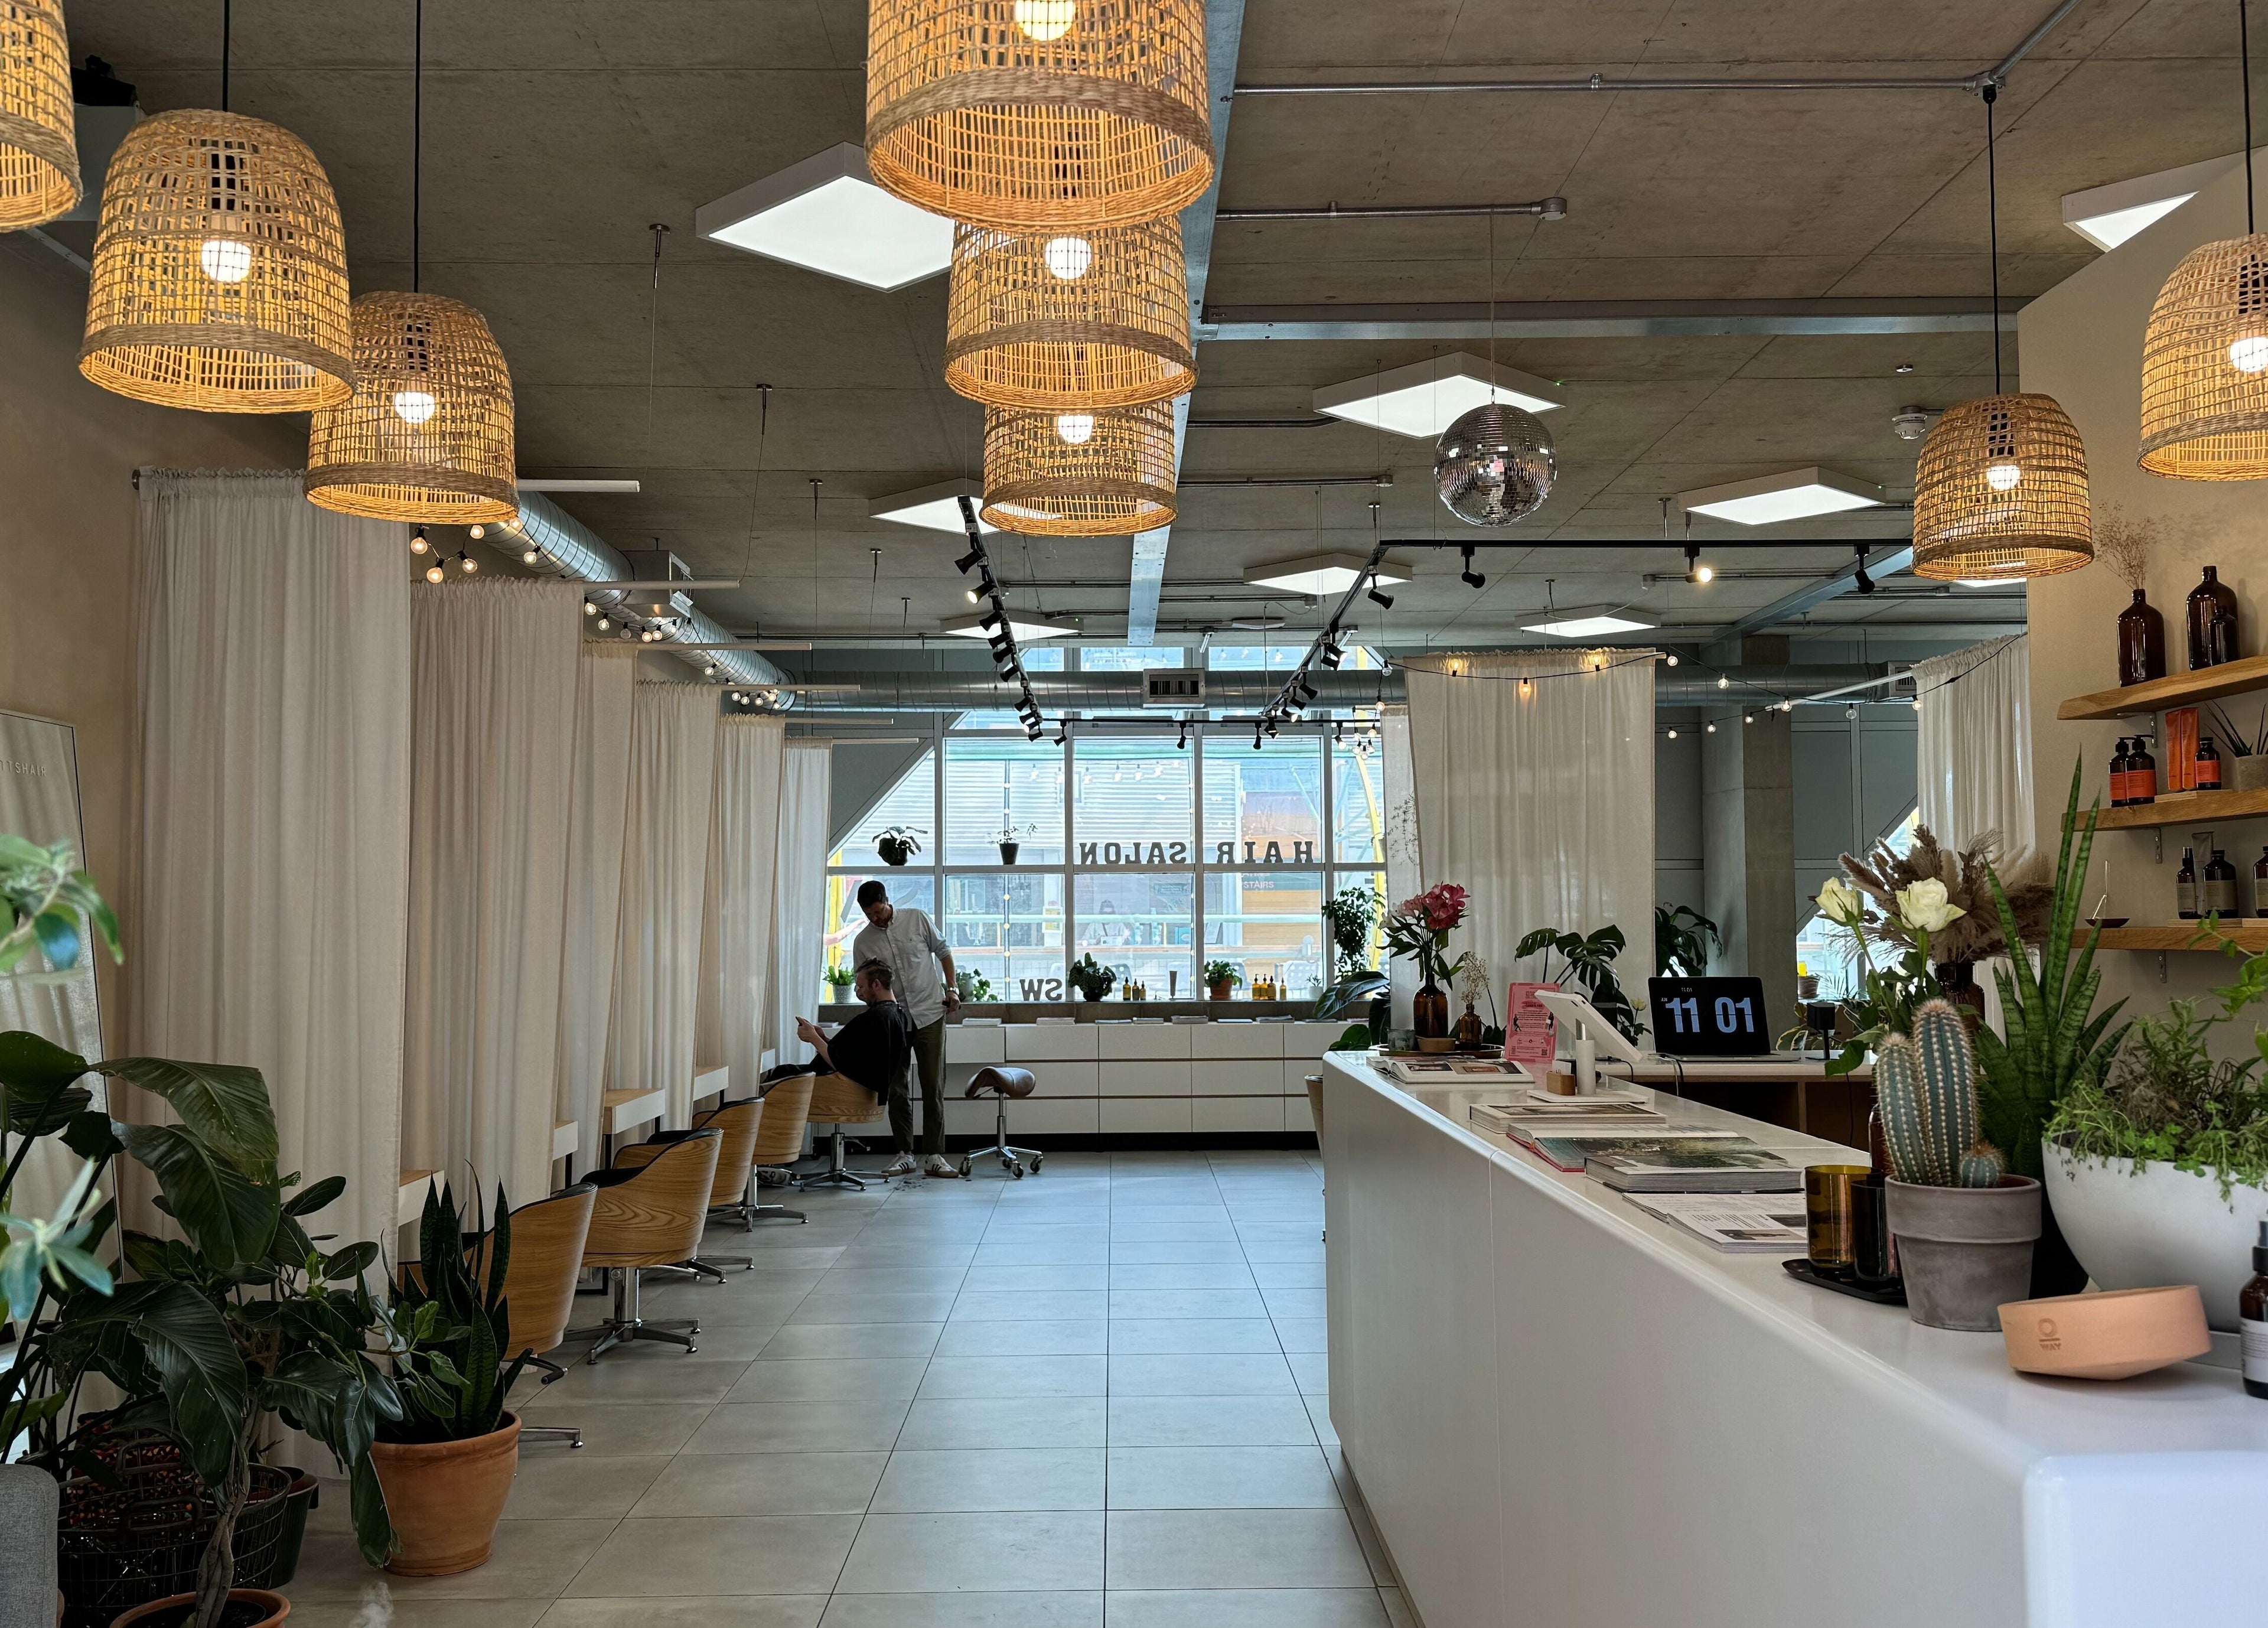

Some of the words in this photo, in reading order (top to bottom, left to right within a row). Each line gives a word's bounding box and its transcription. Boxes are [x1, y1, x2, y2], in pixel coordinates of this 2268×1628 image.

[1665, 997, 1700, 1033] 11
[1715, 997, 1754, 1033] 01
[2039, 1343, 2062, 1351] WAY
